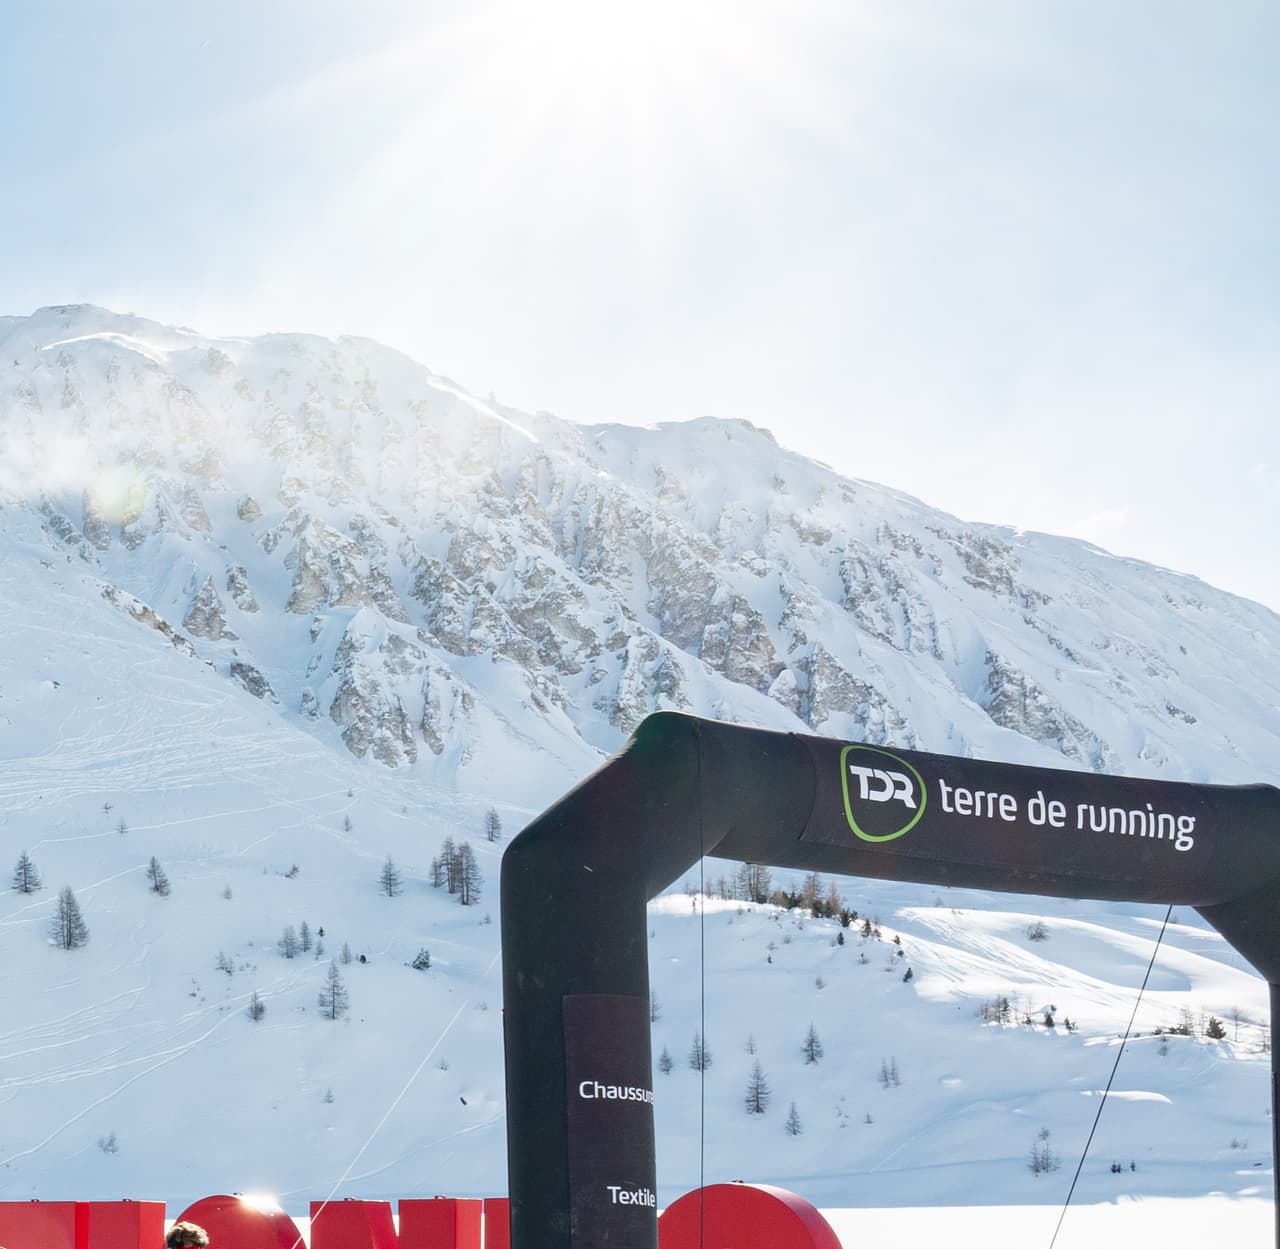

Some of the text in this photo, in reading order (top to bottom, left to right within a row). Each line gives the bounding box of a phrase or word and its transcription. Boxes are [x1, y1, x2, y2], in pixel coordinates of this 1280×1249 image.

[850, 764, 917, 810] TDR
[938, 778, 1196, 852] terre de running
[606, 1185, 656, 1208] Textile
